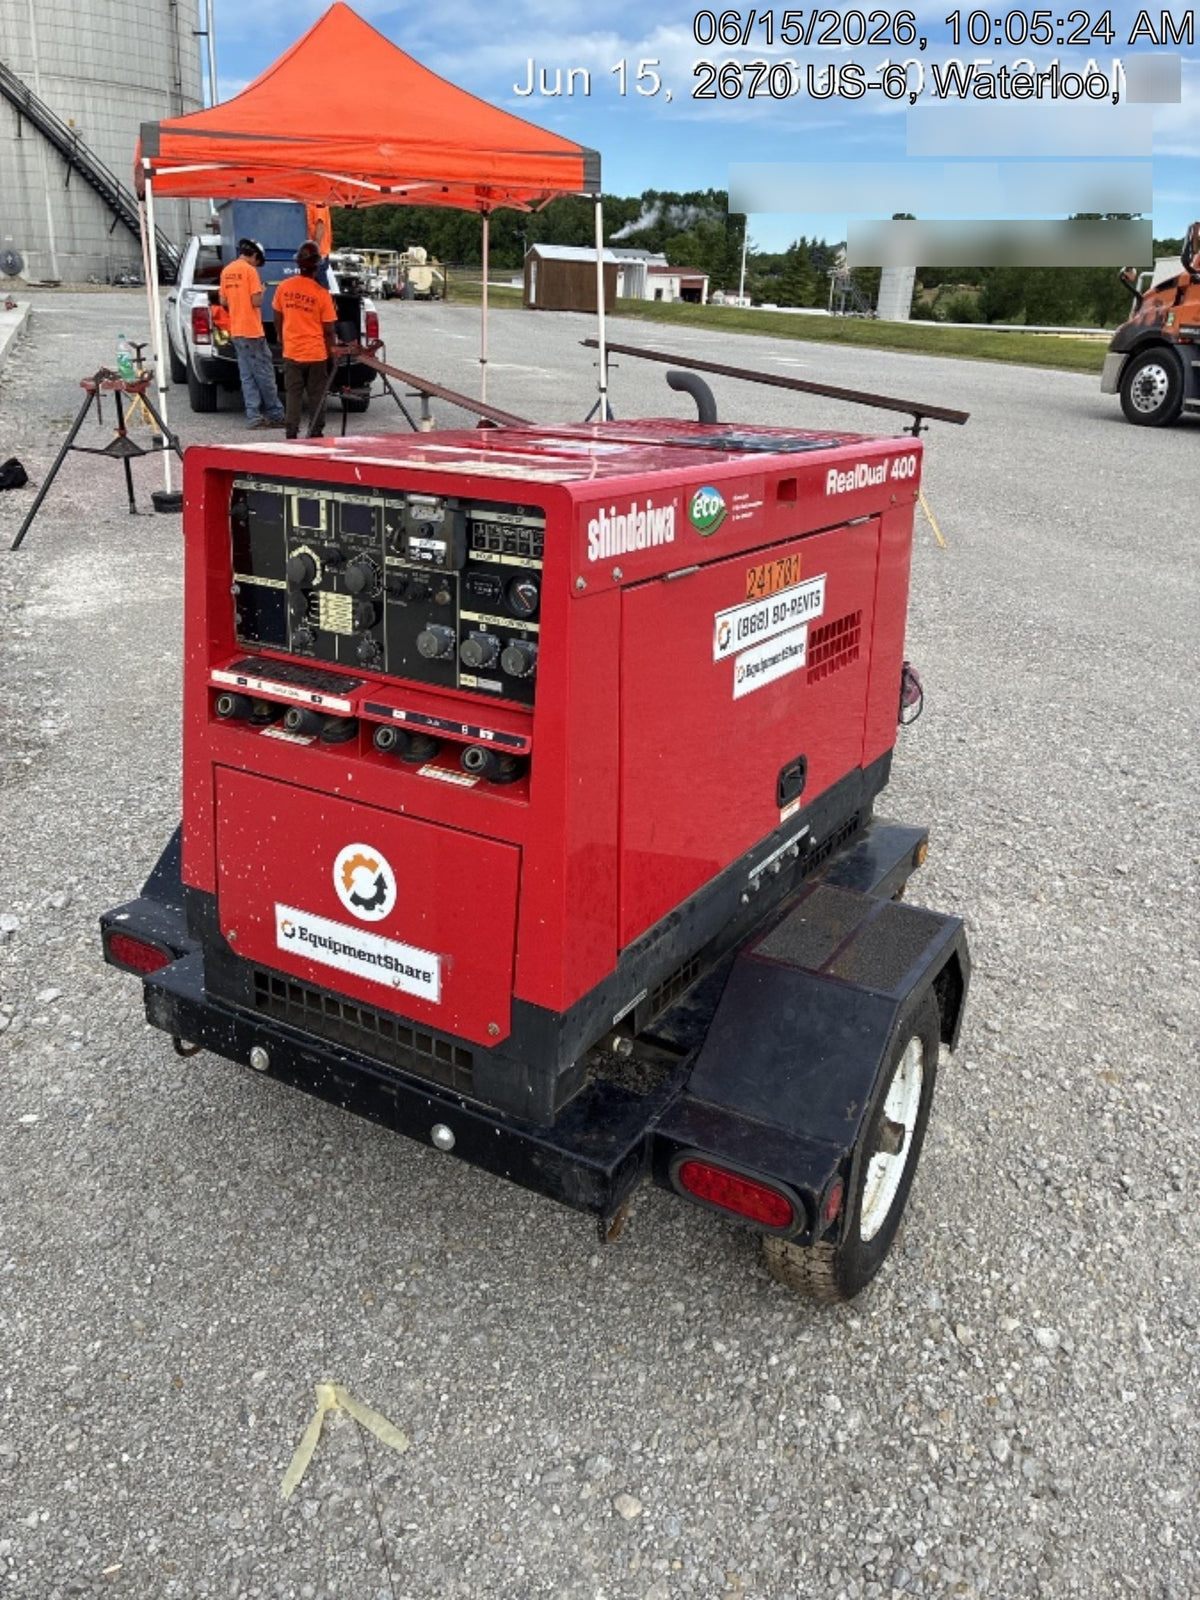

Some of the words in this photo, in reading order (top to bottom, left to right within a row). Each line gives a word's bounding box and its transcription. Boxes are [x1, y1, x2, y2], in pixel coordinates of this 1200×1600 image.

[826, 458, 889, 496] RealDual
[890, 454, 917, 481] 400
[587, 498, 676, 562] shindaiwa
[737, 607, 769, 641] (888)
[746, 643, 804, 678] EquipmentShare
[298, 926, 432, 984] EquipmentShare
